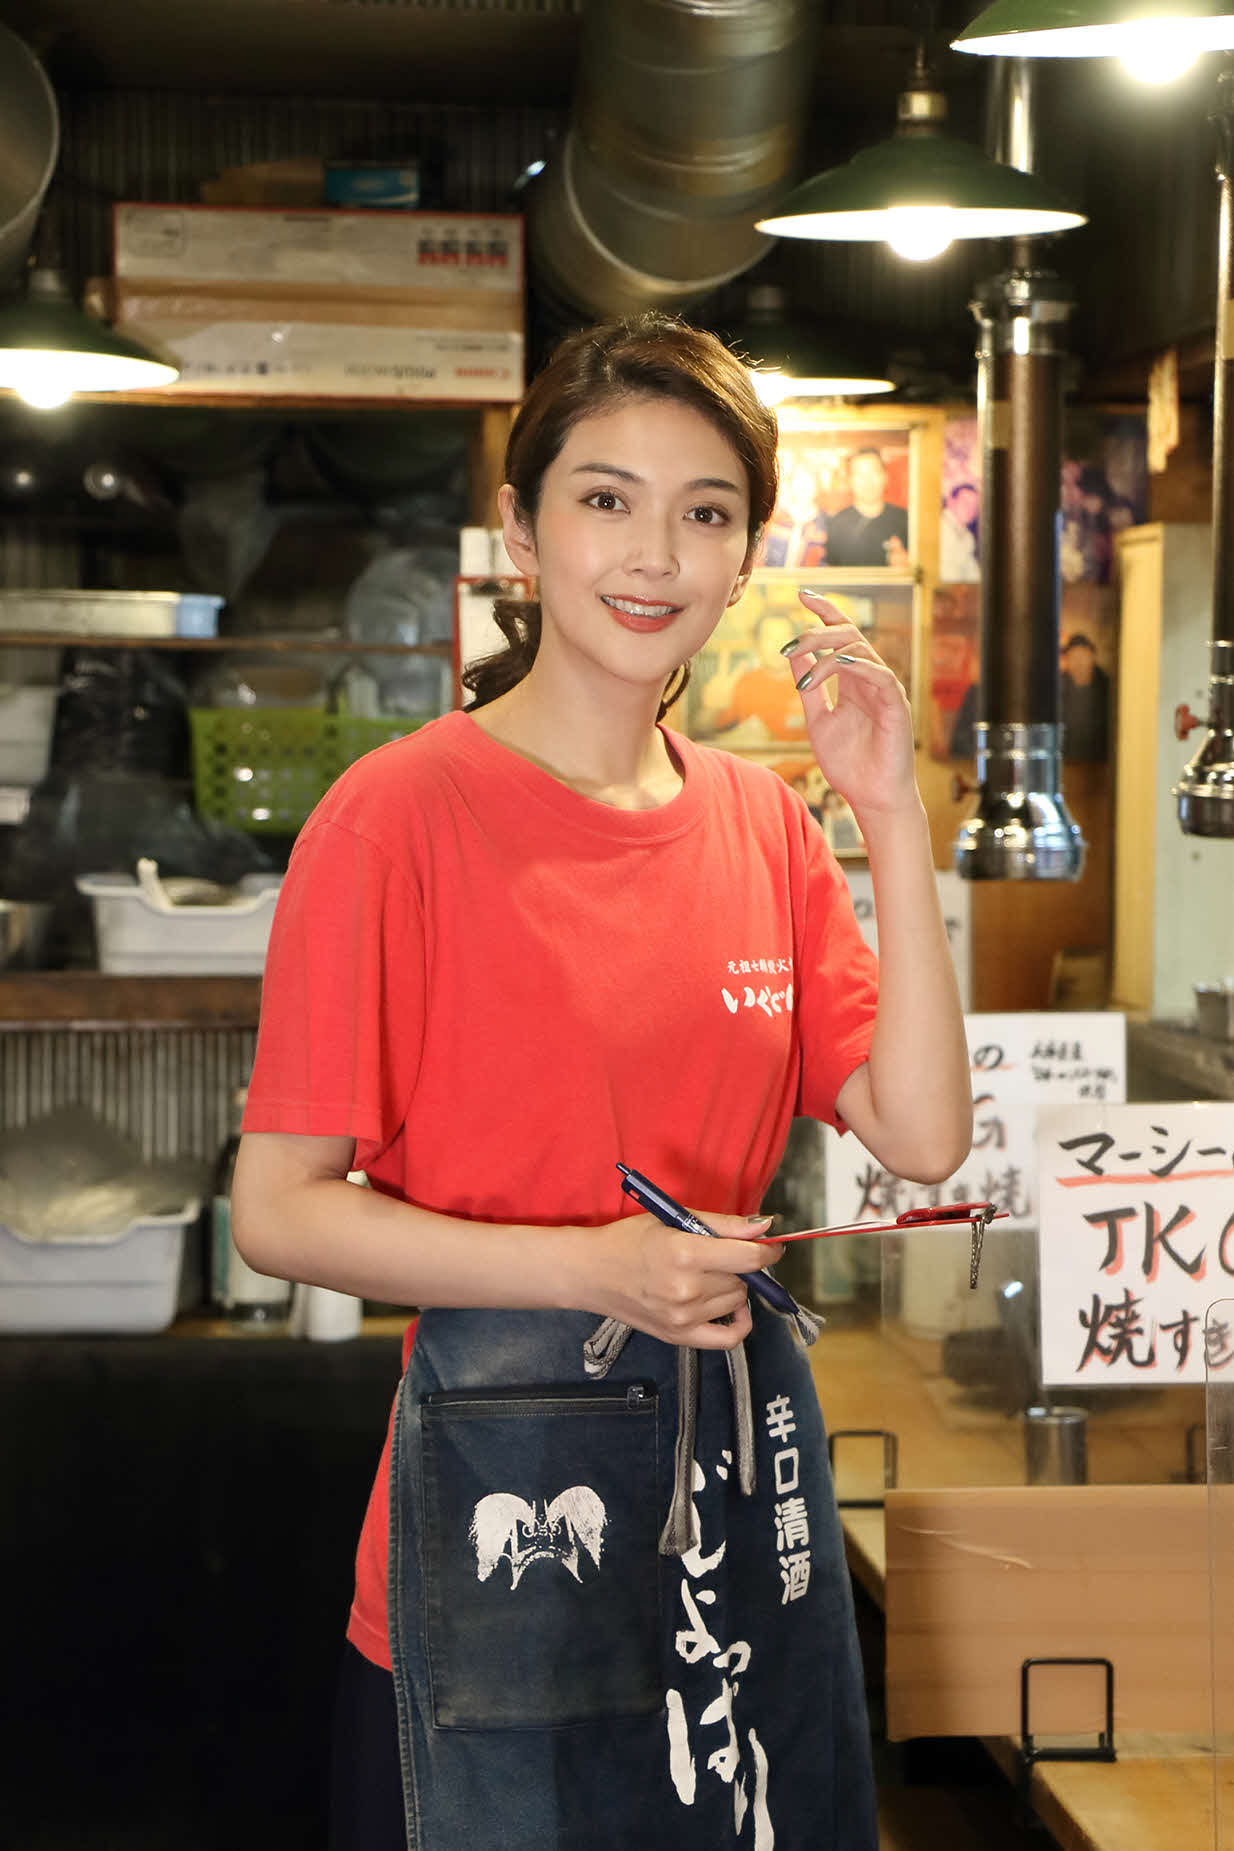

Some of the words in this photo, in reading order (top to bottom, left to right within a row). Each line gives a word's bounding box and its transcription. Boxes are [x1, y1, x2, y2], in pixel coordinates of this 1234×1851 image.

[1057, 1125, 1234, 1177] マーシー
[766, 1394, 812, 1606] 辛口清酒
